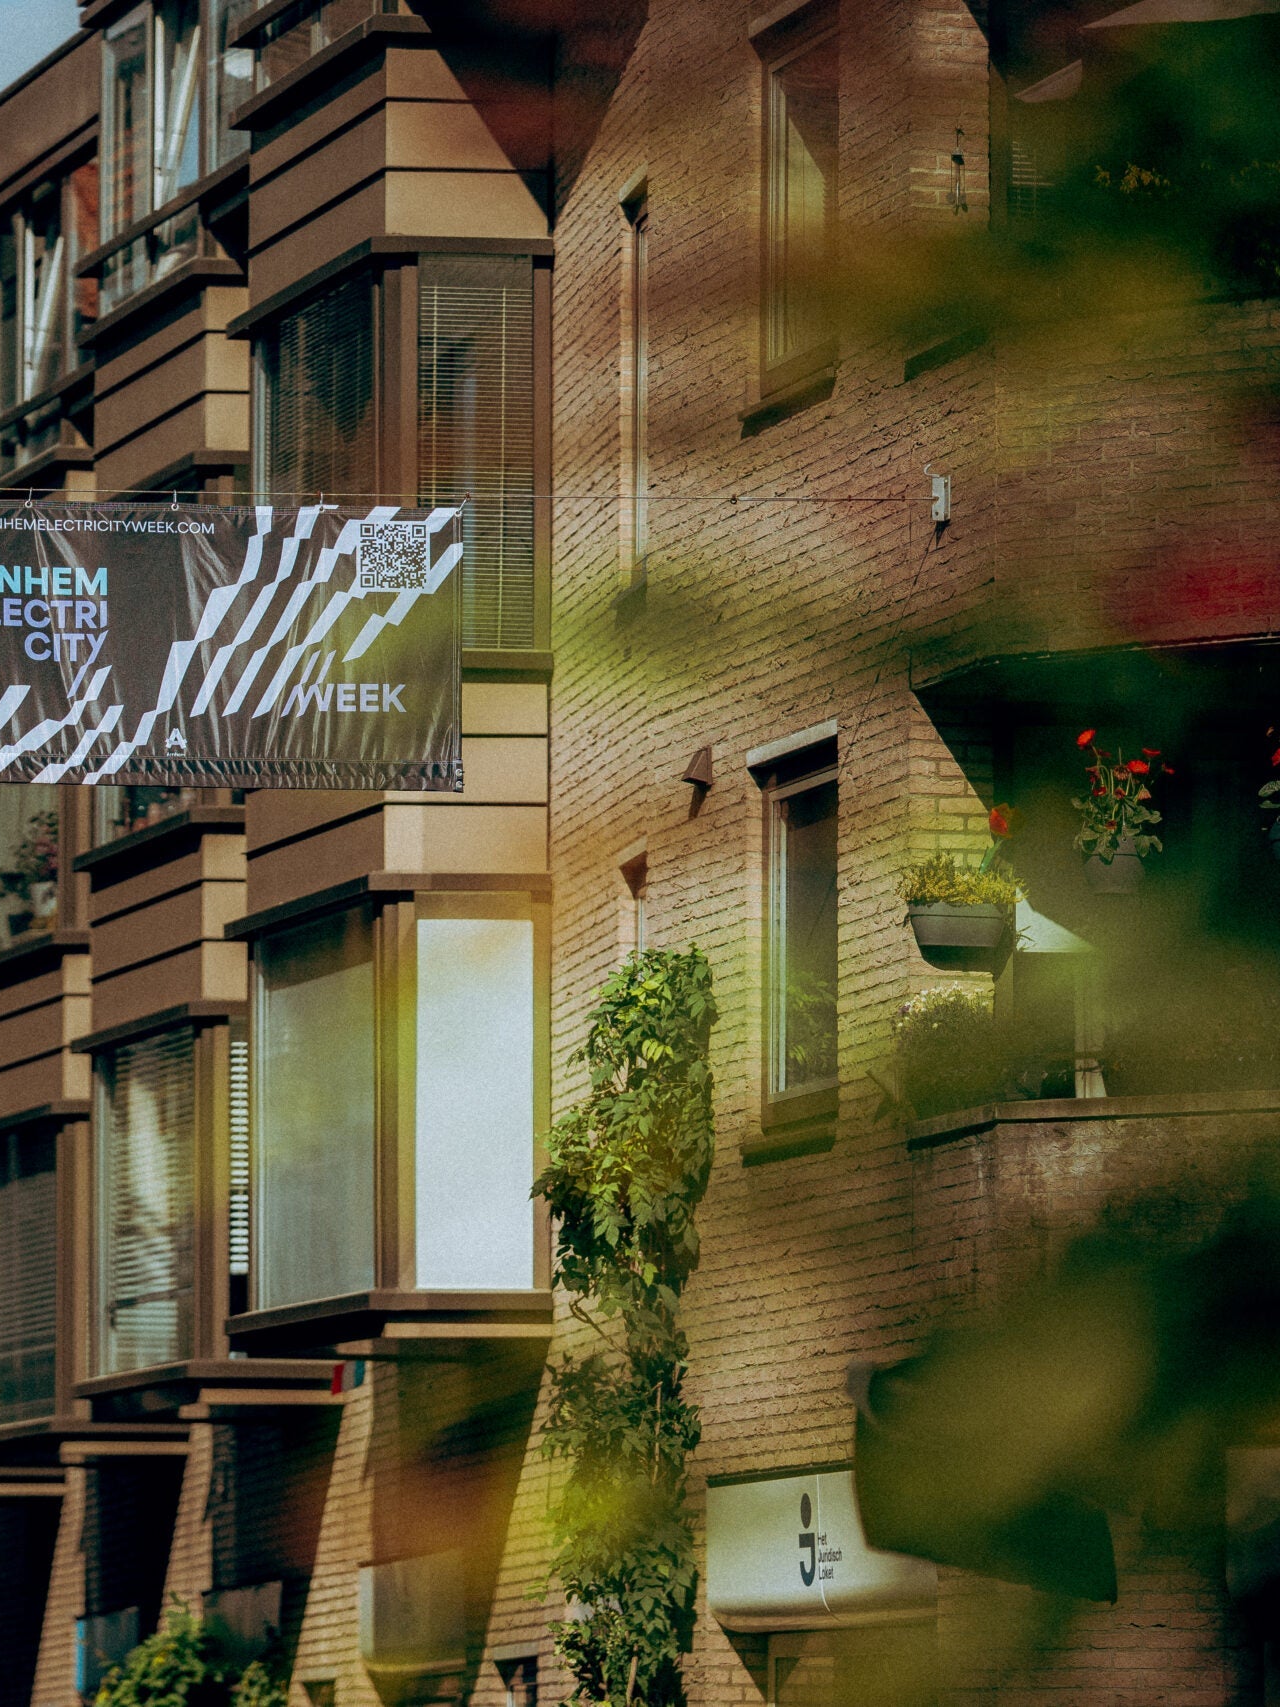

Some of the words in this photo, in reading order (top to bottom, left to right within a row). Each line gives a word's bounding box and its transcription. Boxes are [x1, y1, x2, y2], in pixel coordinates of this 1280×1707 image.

[23, 629, 109, 699] CITY
[280, 682, 407, 718] WEEK
[818, 1547, 843, 1564] Juridisch
[818, 1565, 835, 1580] Loket
